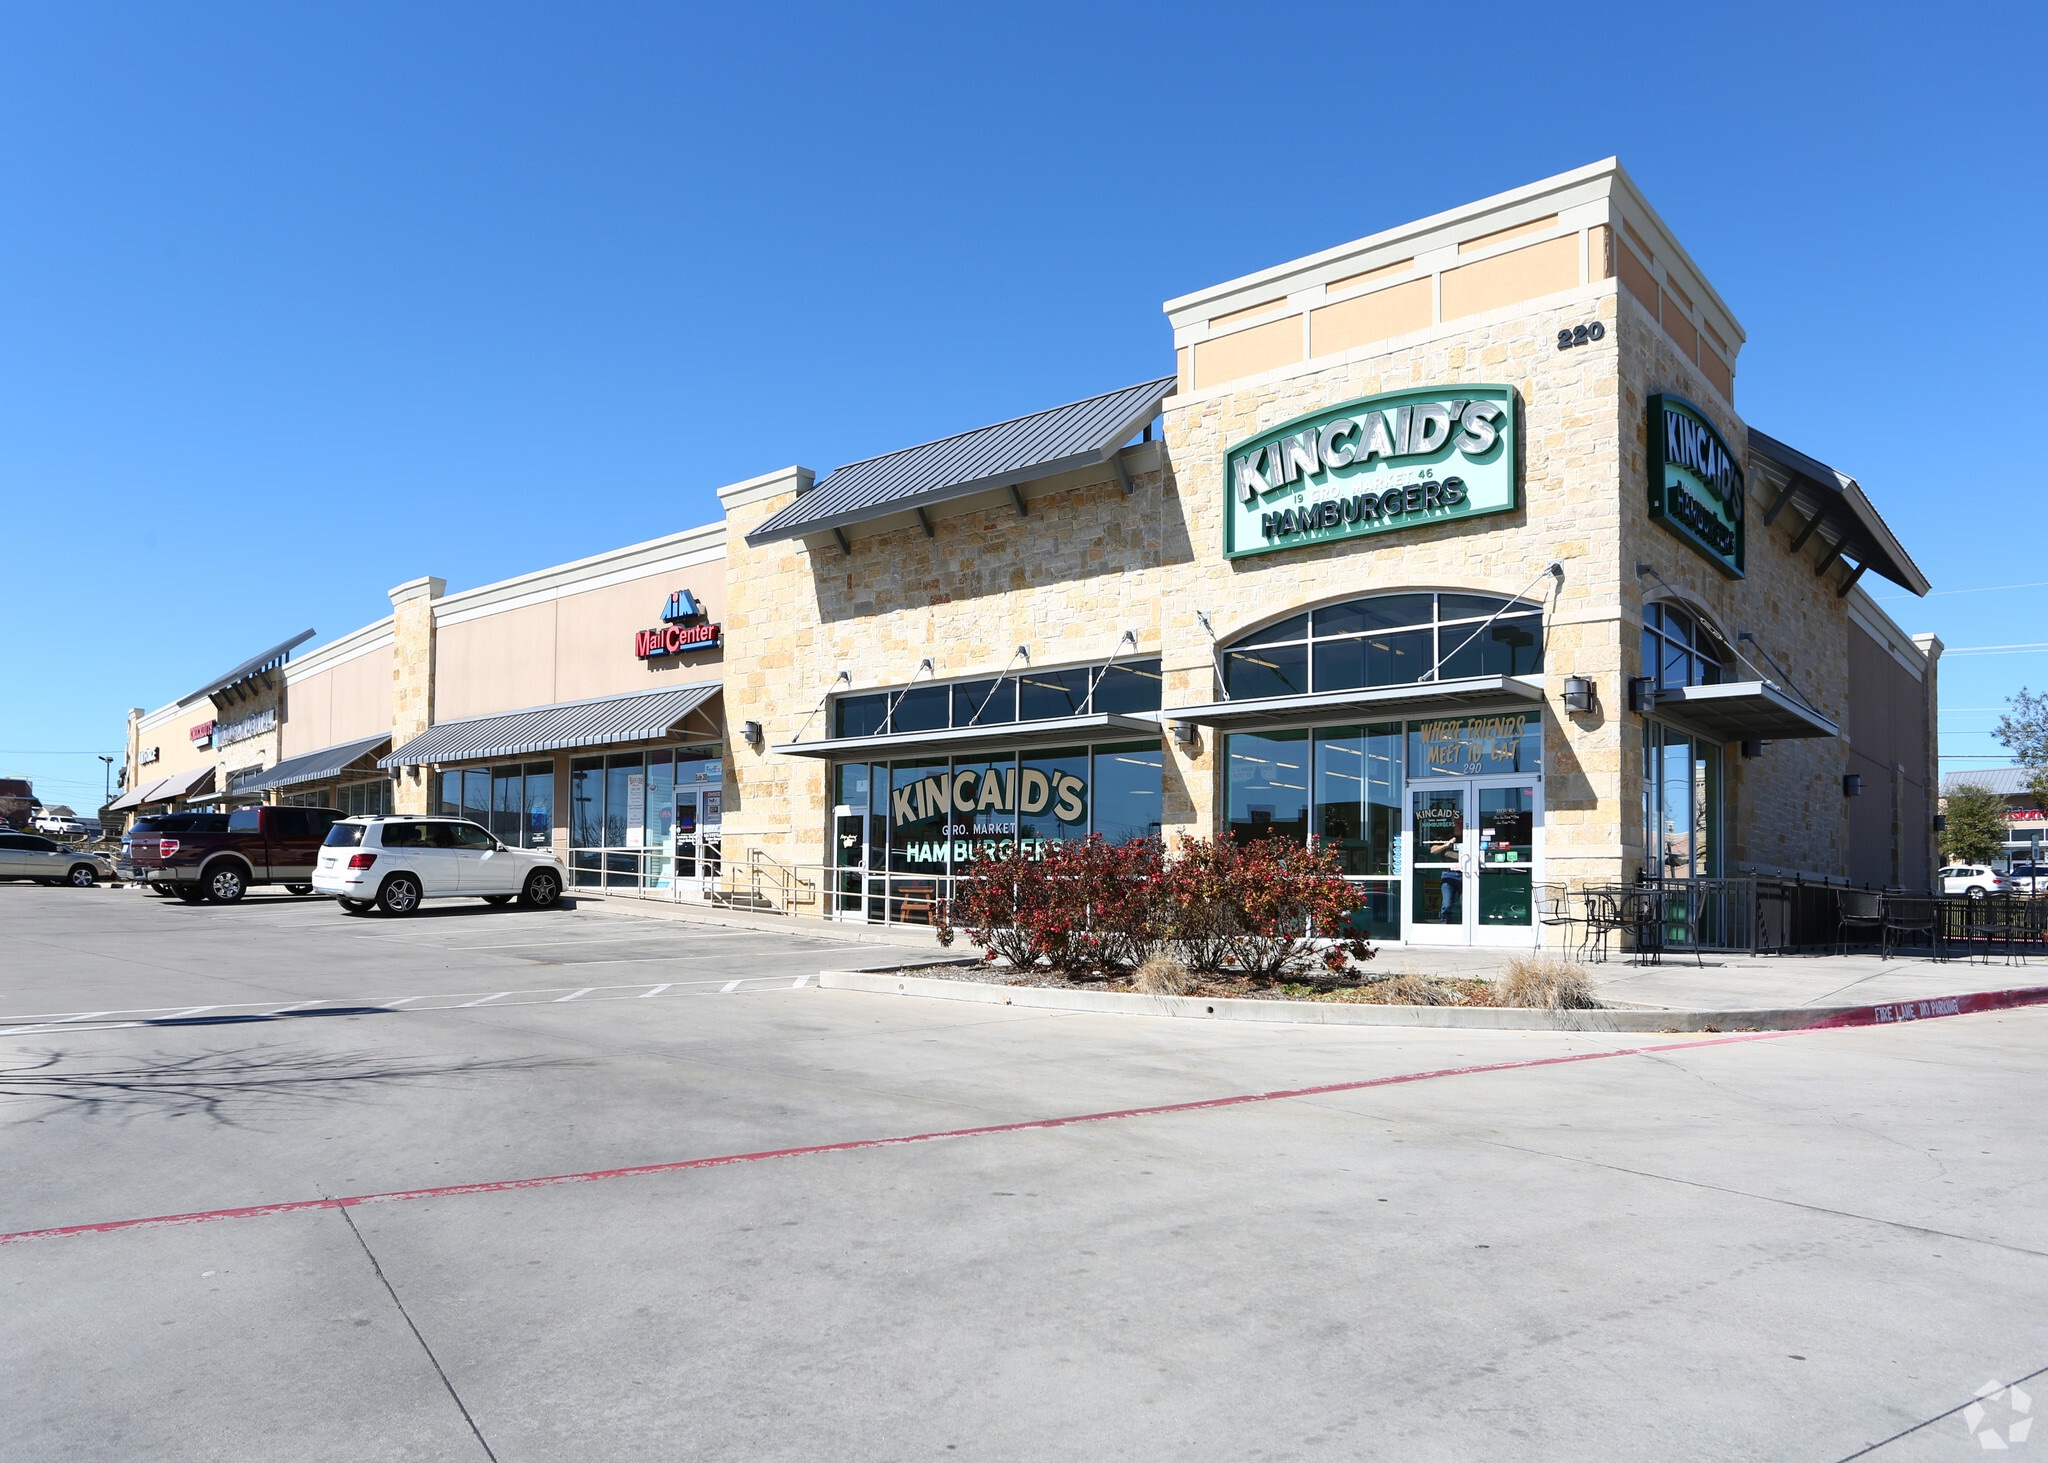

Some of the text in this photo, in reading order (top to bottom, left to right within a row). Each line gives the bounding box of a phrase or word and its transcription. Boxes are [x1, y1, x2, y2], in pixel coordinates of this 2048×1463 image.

[1557, 321, 1604, 351] 220
[1233, 399, 1501, 503] KINCAID'S
[1418, 468, 1434, 479] 46
[1666, 411, 1743, 521] KINCAID'S
[1294, 494, 1304, 504] 19
[1310, 472, 1413, 502] GRO. MARKET
[1262, 476, 1467, 538] HAMBURGERS
[635, 624, 715, 657] Mail Center
[1421, 715, 1526, 744] WHERE FRIENDS
[1427, 740, 1519, 764] MEET TO EAT
[1463, 763, 1482, 774] 290
[892, 768, 1087, 826] KINCAID'S
[1415, 808, 1460, 820] KINCAID'S
[942, 822, 1016, 836] GRO. MARKET
[1874, 1000, 1959, 1023] FIRE LANE NO PARKING
